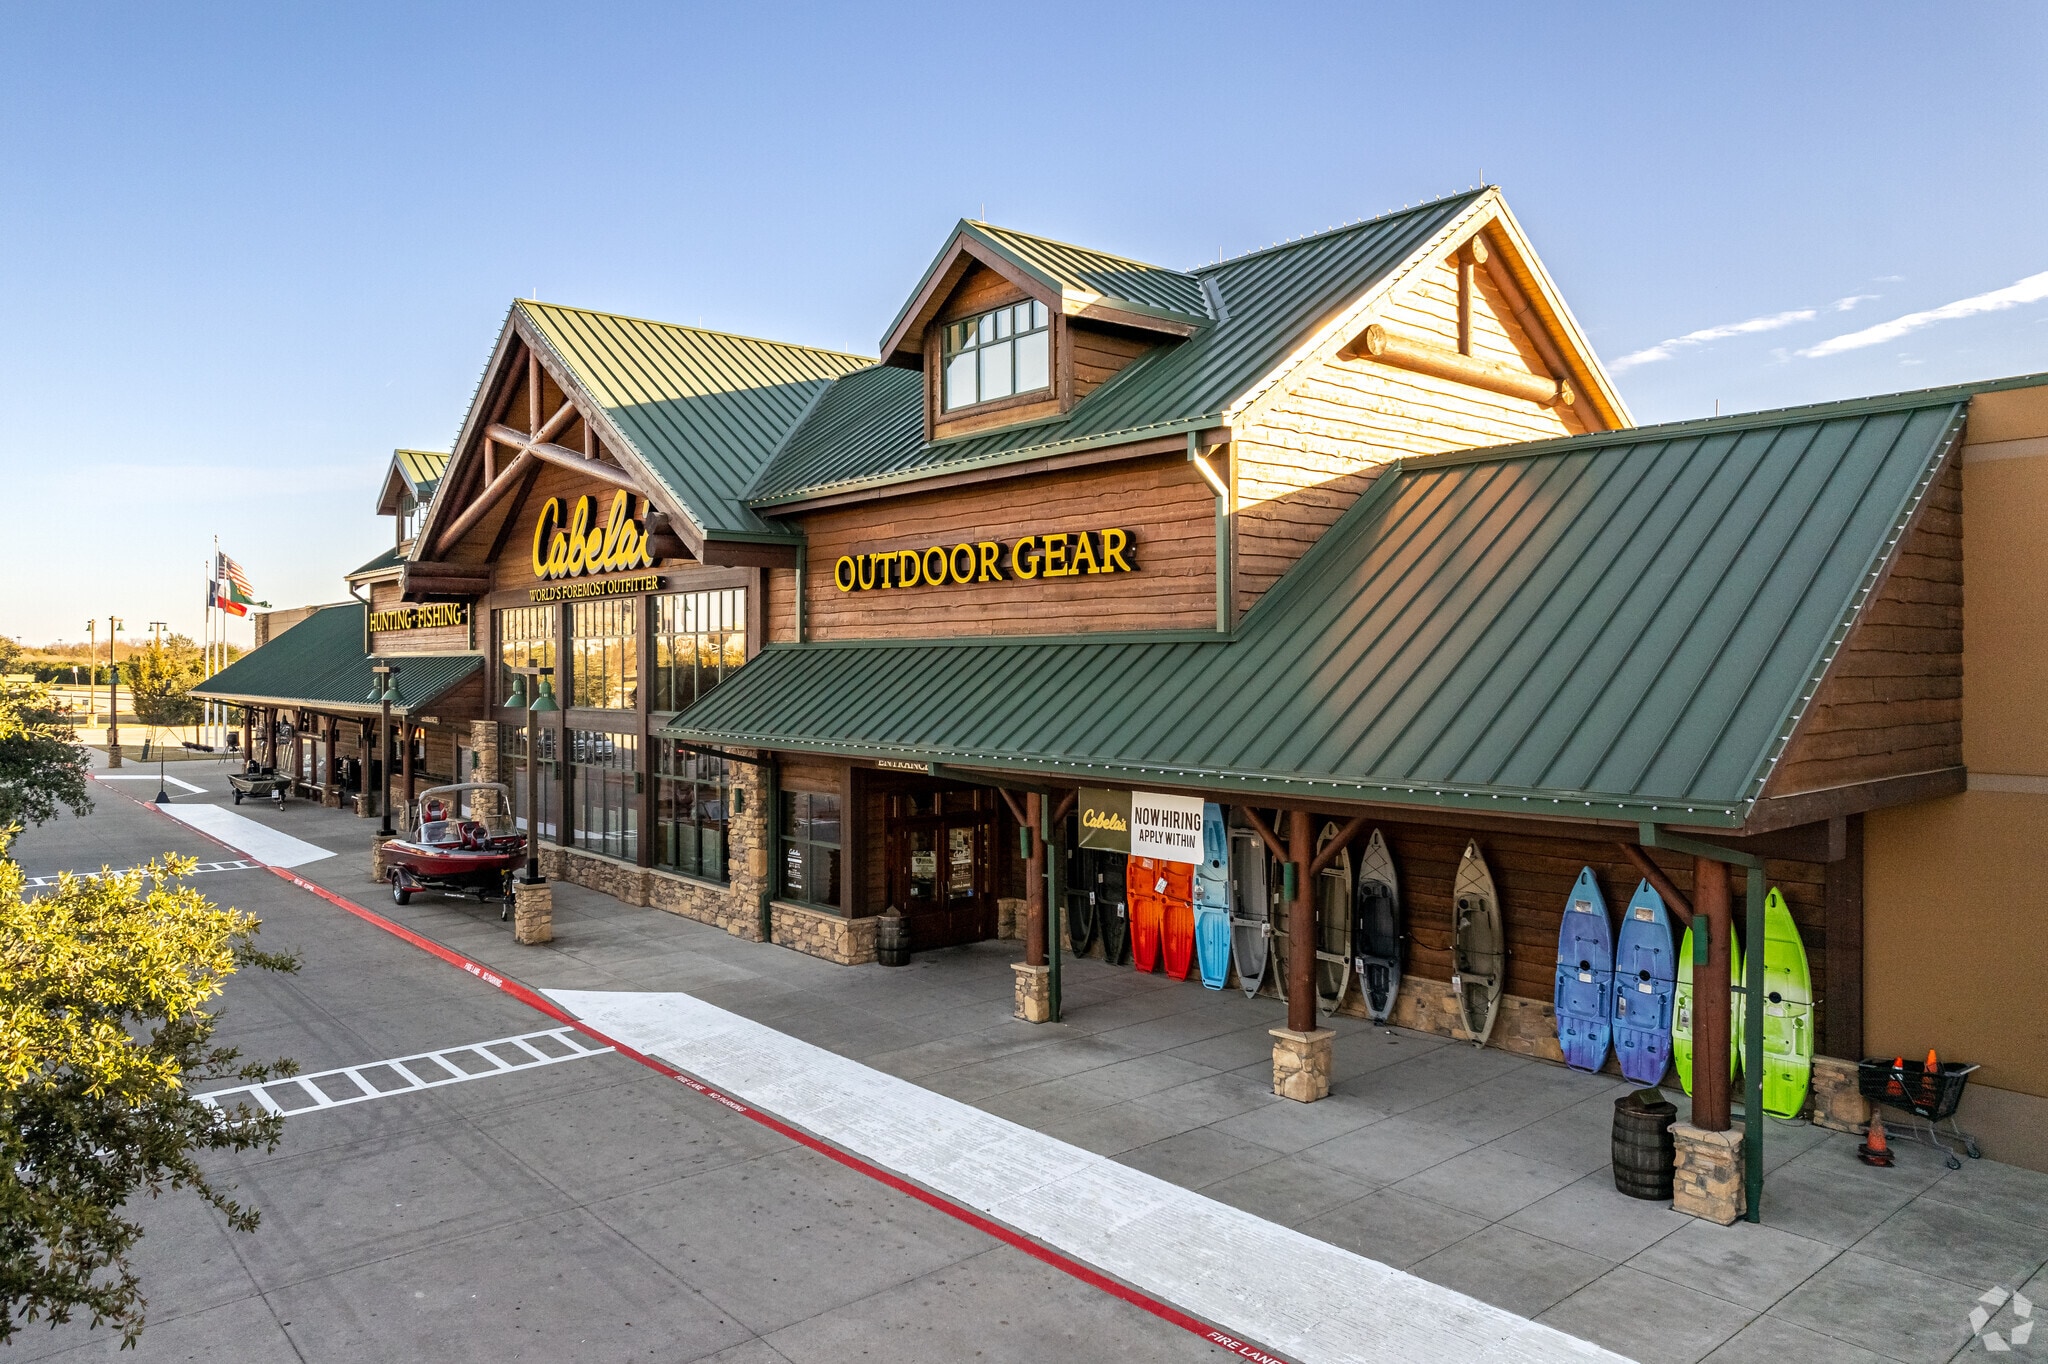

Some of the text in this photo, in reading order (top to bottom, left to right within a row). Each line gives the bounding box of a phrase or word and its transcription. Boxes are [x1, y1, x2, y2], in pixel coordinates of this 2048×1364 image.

[834, 527, 1131, 593] OUTDOOR GEAR
[529, 575, 659, 602] WORLD'S FOREMOST OUTFITTER
[369, 602, 462, 632] HUNTING FISHING
[1082, 808, 1128, 832] Cabela's
[1134, 806, 1201, 832] NOW HIRING
[1138, 828, 1196, 849] APPLY WITHIN
[1206, 1331, 1242, 1350] FIRE
